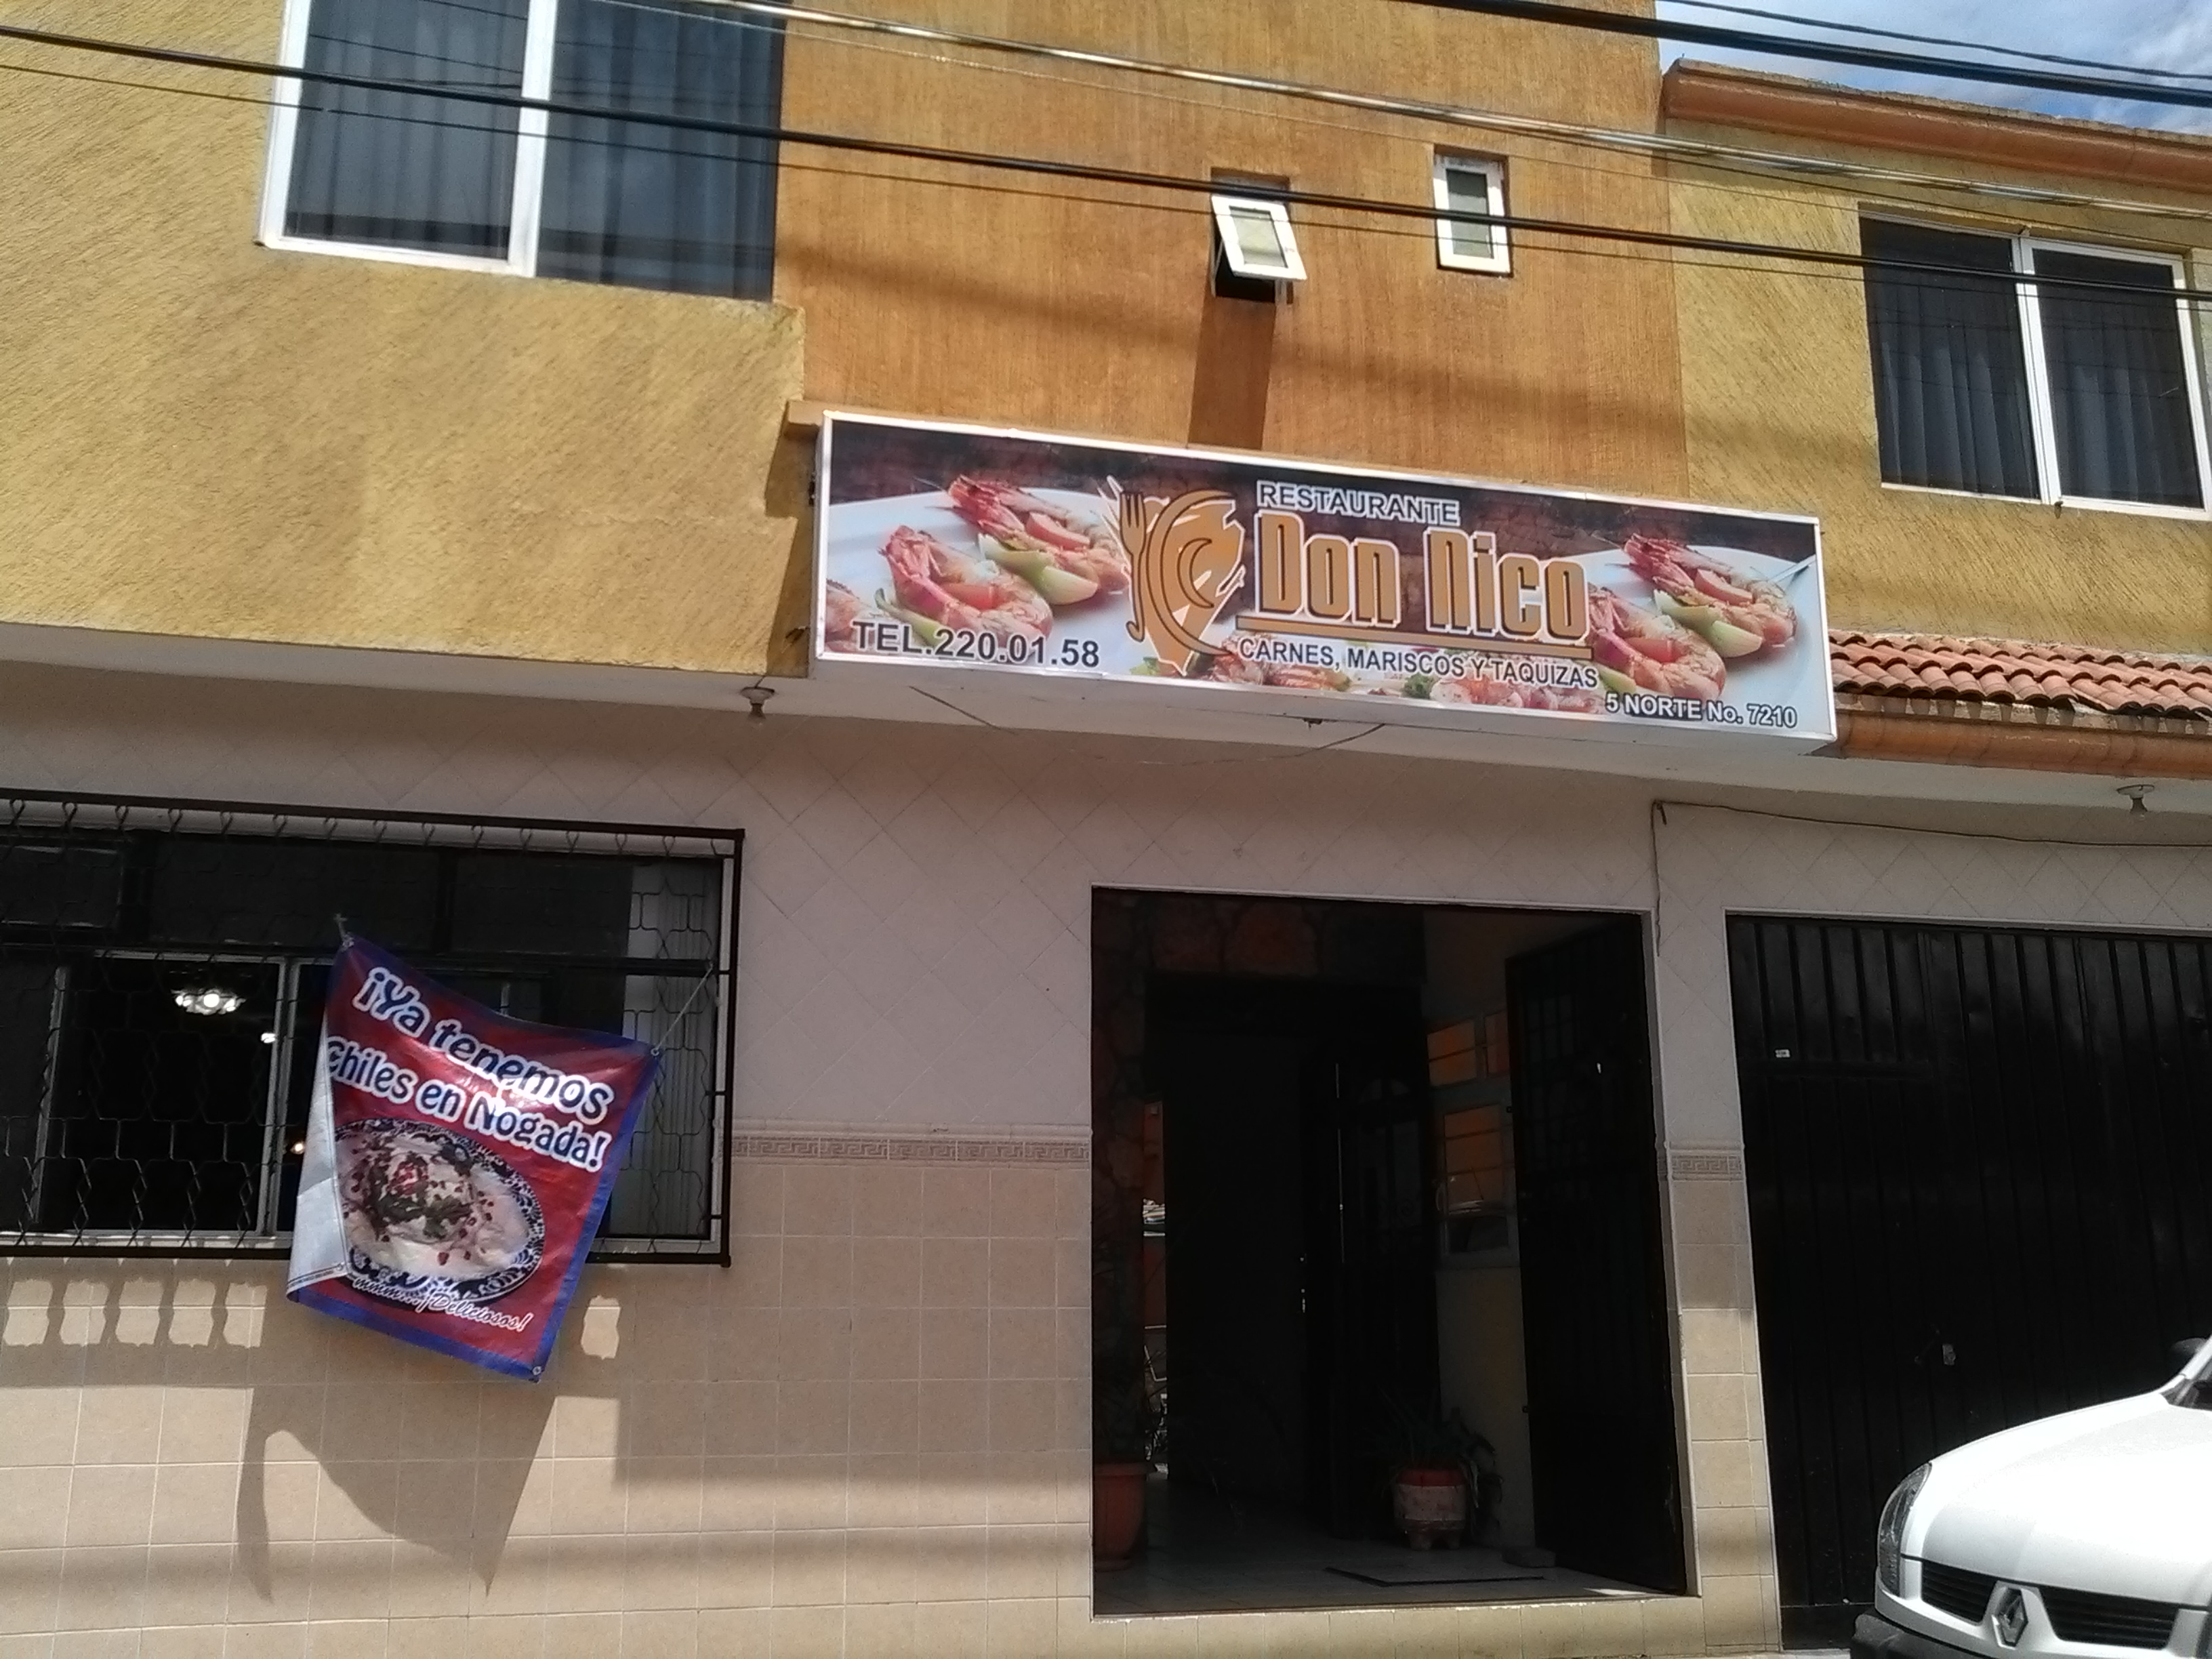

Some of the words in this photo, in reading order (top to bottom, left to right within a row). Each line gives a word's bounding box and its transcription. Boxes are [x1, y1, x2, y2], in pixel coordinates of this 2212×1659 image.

[1257, 480, 1460, 525] RESTAURANTE
[1254, 510, 1401, 628] Don
[1423, 527, 1590, 646] Nico
[1238, 637, 1341, 670] CARNES,
[1346, 647, 1465, 678] MARISCOS
[1471, 657, 1486, 679] Y
[1490, 660, 1599, 689] TAQUIZAS
[1605, 691, 1620, 712] 5
[1624, 694, 1702, 720] NORTE
[1706, 700, 1743, 724] No.
[1746, 703, 1798, 727] 7210
[430, 1020, 613, 1124] tenemos
[415, 1080, 466, 1122] en
[464, 1093, 611, 1171] Nogada!
